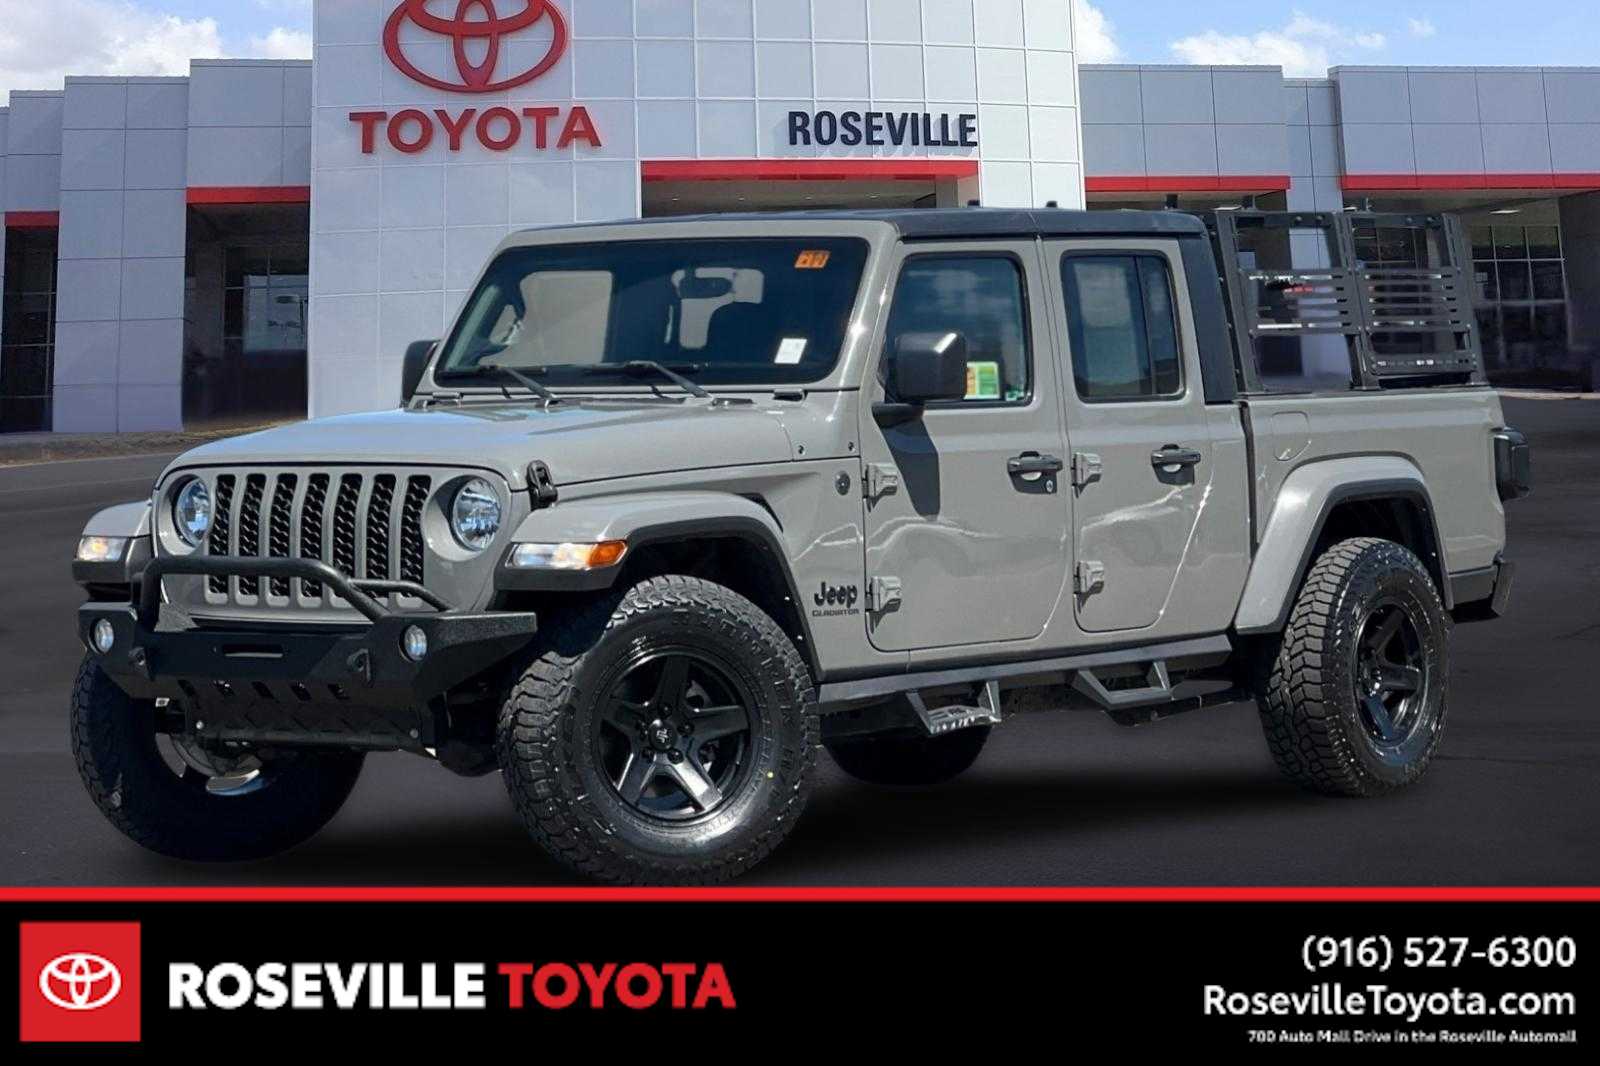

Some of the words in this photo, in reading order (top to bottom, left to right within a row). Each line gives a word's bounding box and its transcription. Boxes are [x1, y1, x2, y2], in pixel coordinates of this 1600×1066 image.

[350, 106, 602, 153] TOYOTA
[788, 110, 978, 147] ROSEVILLE
[814, 581, 857, 608] Jeep
[812, 608, 859, 617] GLADIATOR
